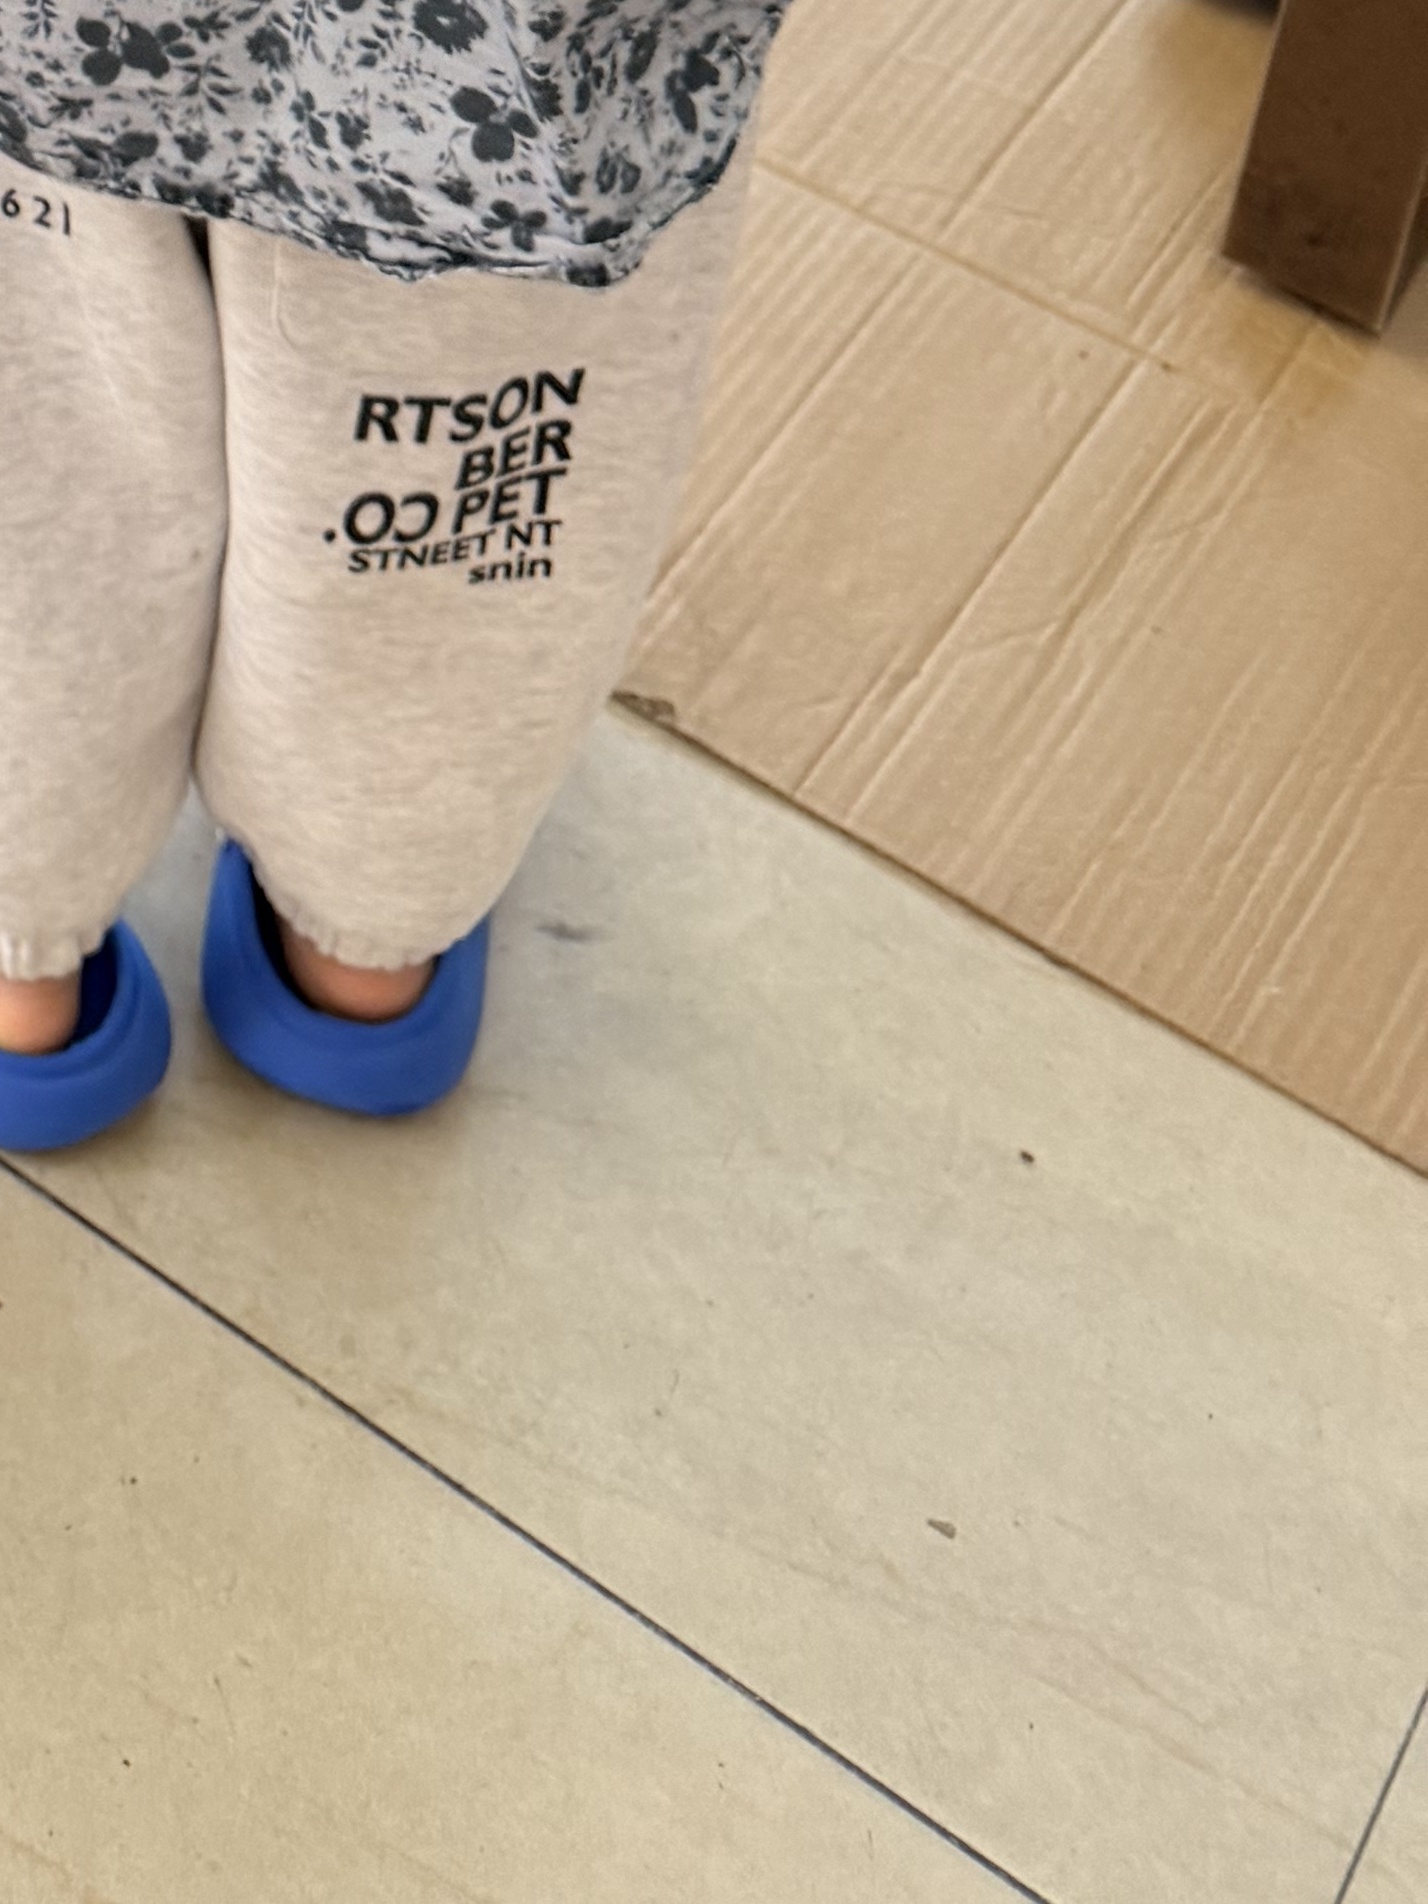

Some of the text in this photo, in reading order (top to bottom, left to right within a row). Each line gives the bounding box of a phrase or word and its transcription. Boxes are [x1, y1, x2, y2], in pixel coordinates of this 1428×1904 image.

[354, 368, 586, 444] RTSON
[455, 419, 572, 491] BER
[452, 467, 567, 534] PET
